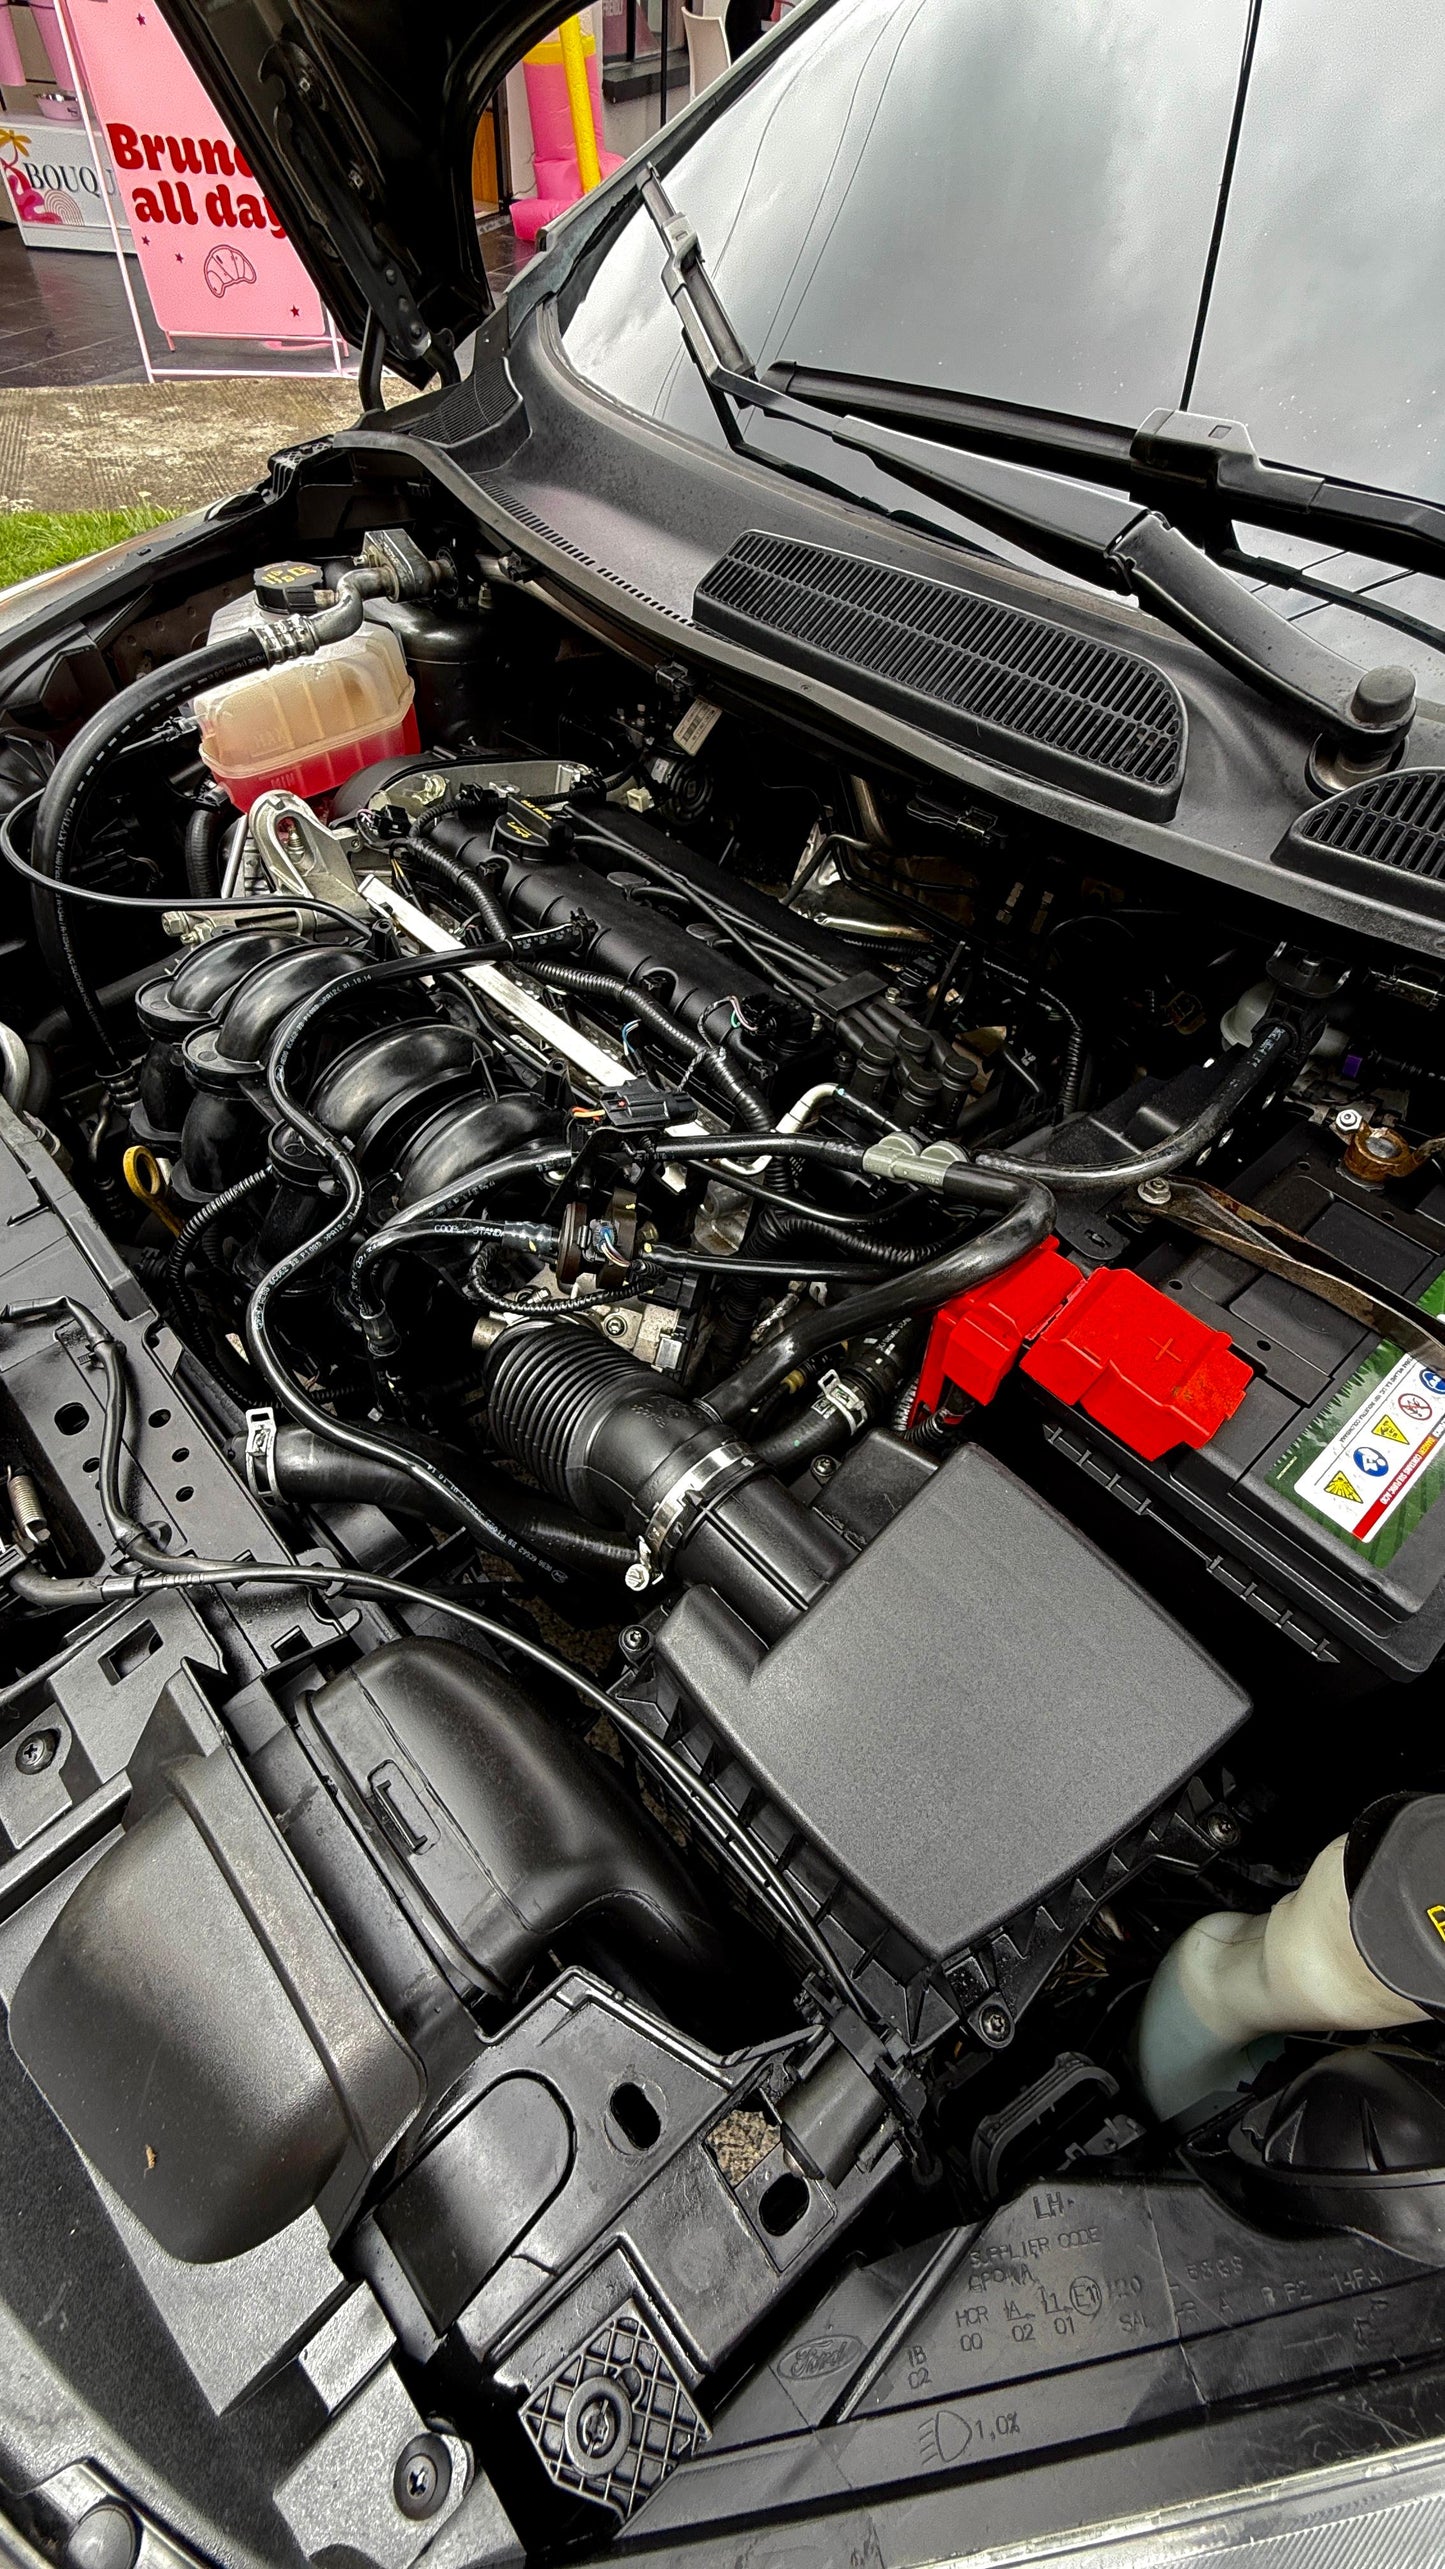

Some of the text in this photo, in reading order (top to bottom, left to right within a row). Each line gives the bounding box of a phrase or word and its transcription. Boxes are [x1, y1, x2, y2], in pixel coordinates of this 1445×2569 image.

[132, 180, 198, 225] all
[57, 807, 72, 848] GALAXY
[969, 2228, 1101, 2268] SUPPLIER CODE
[1012, 2323, 1036, 2343] 02
[1054, 2315, 1076, 2335] 01
[790, 2340, 847, 2375] Ford
